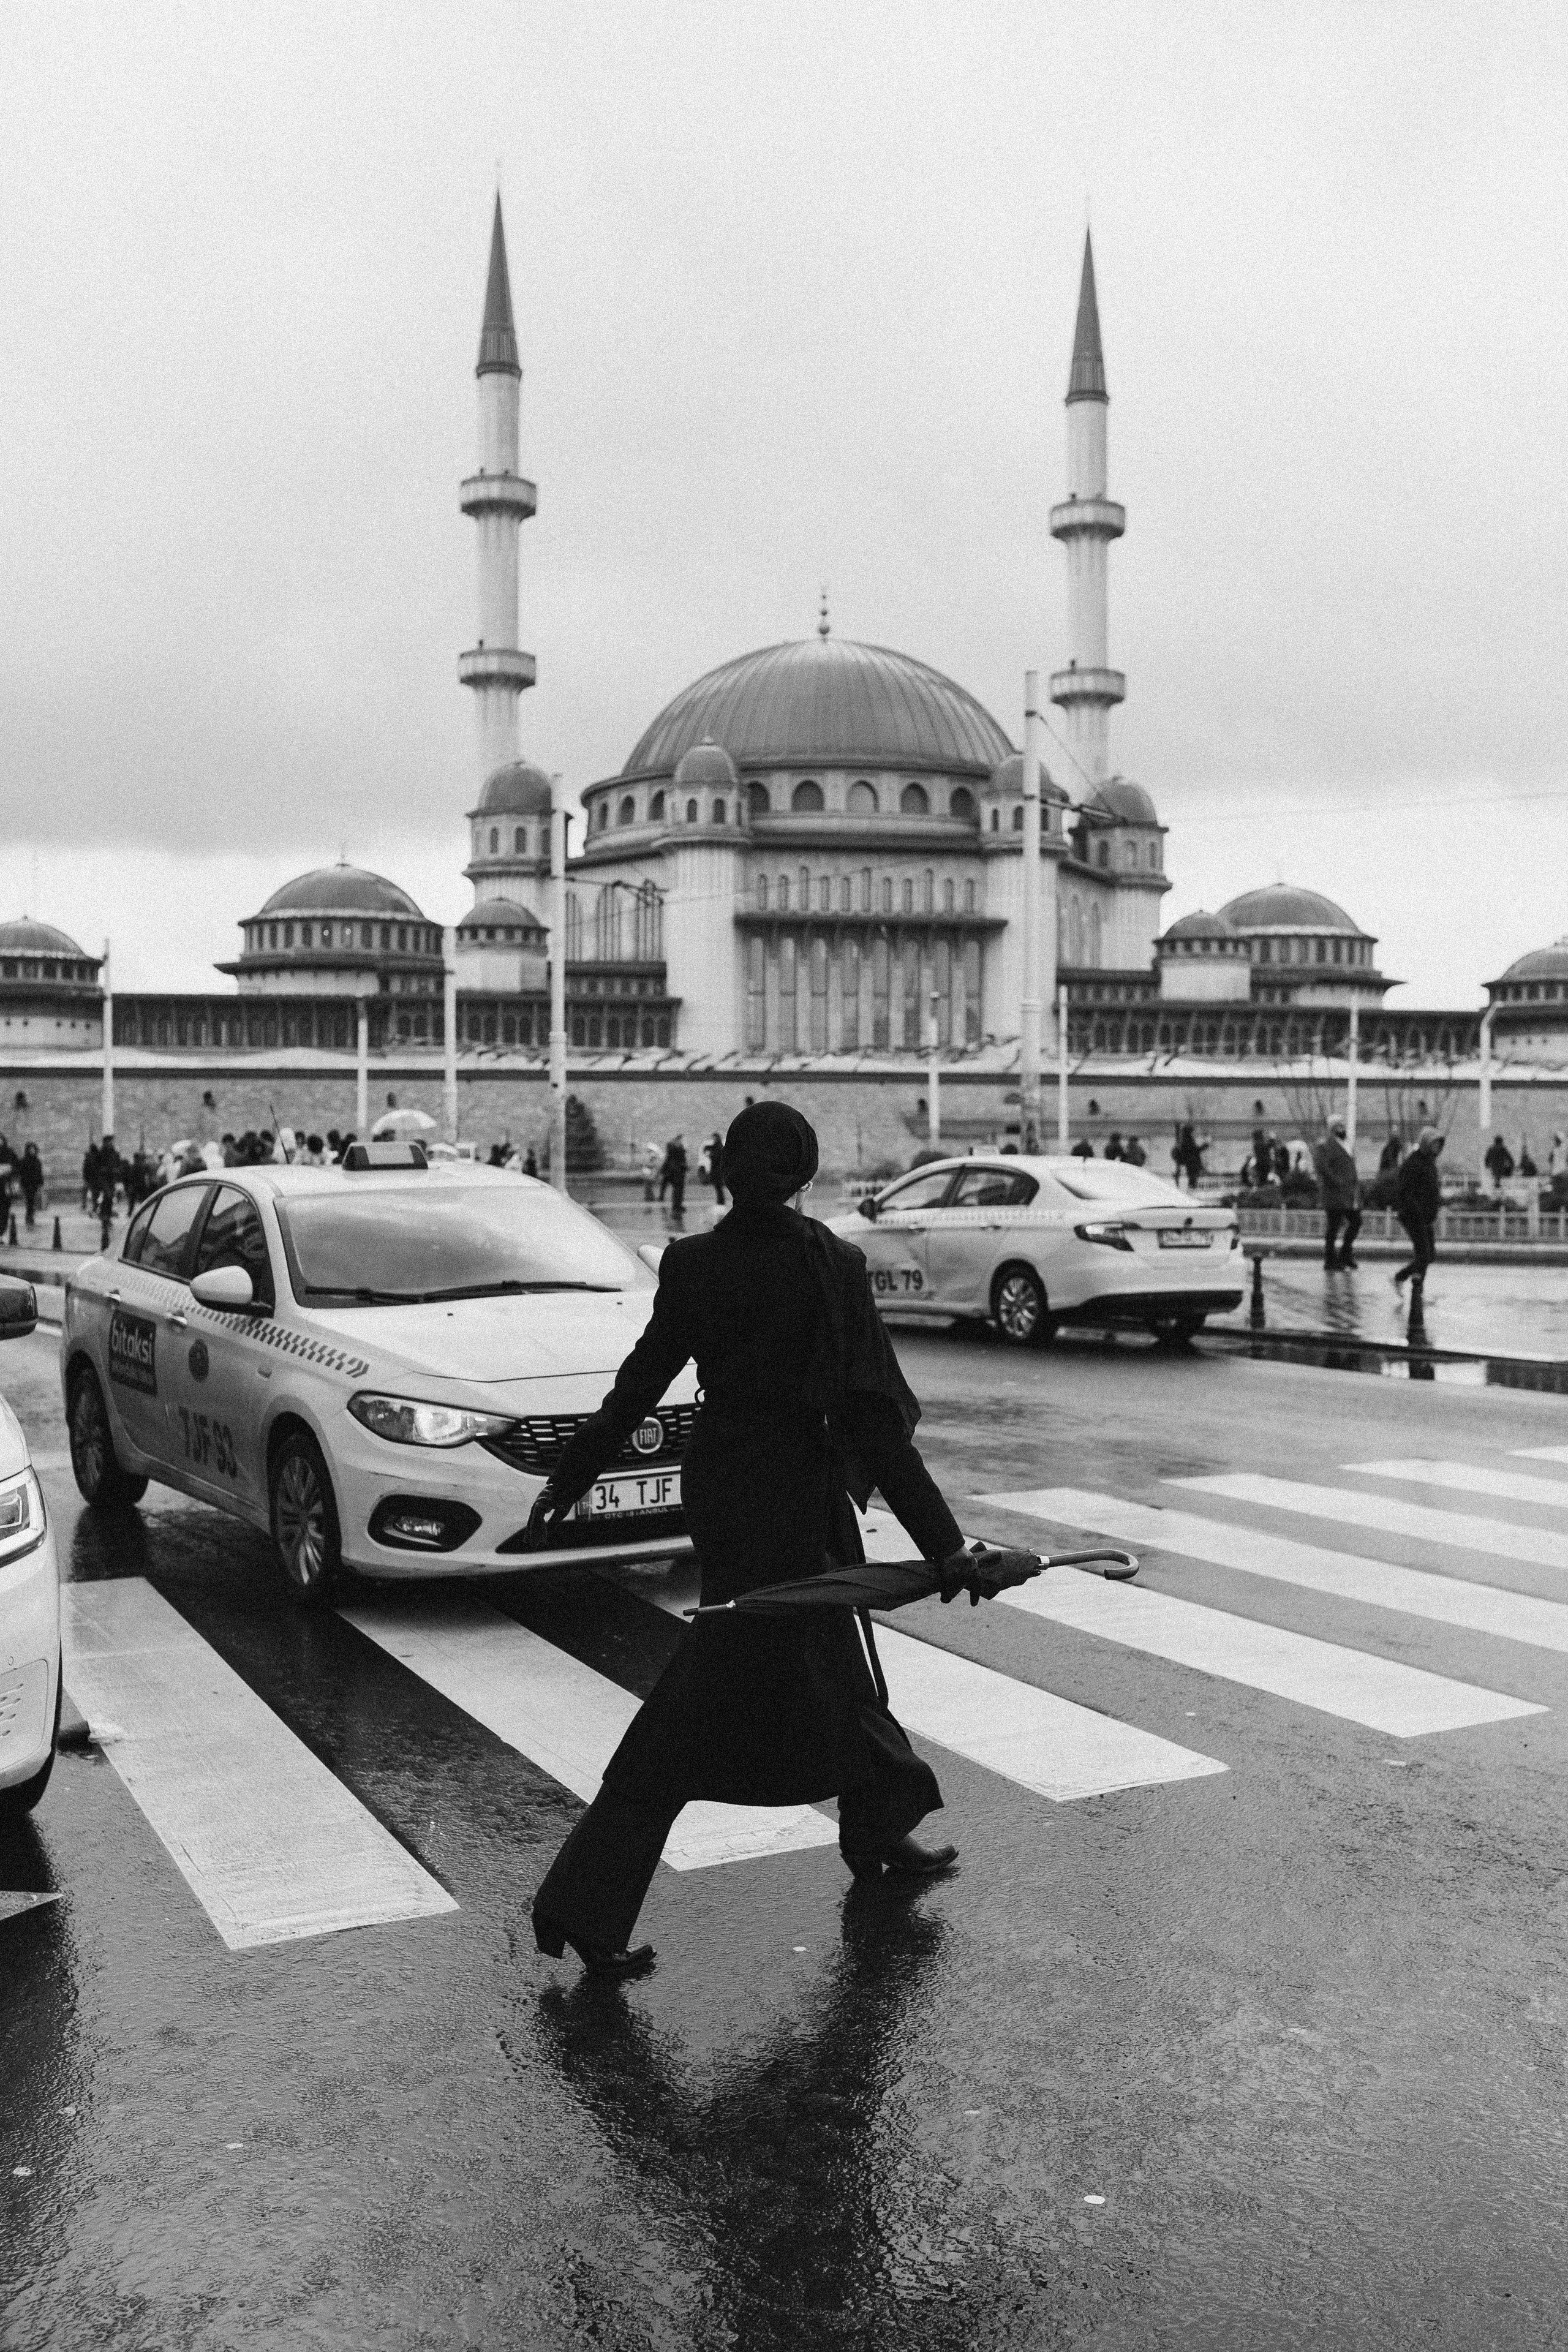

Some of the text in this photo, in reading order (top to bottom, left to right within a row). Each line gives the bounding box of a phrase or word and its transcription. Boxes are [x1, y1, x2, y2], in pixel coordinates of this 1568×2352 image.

[900, 1268, 923, 1291] 79
[111, 1319, 153, 1365] bitaksi
[639, 1428, 657, 1444] FIAT
[595, 1477, 673, 1510] 34 TJF
